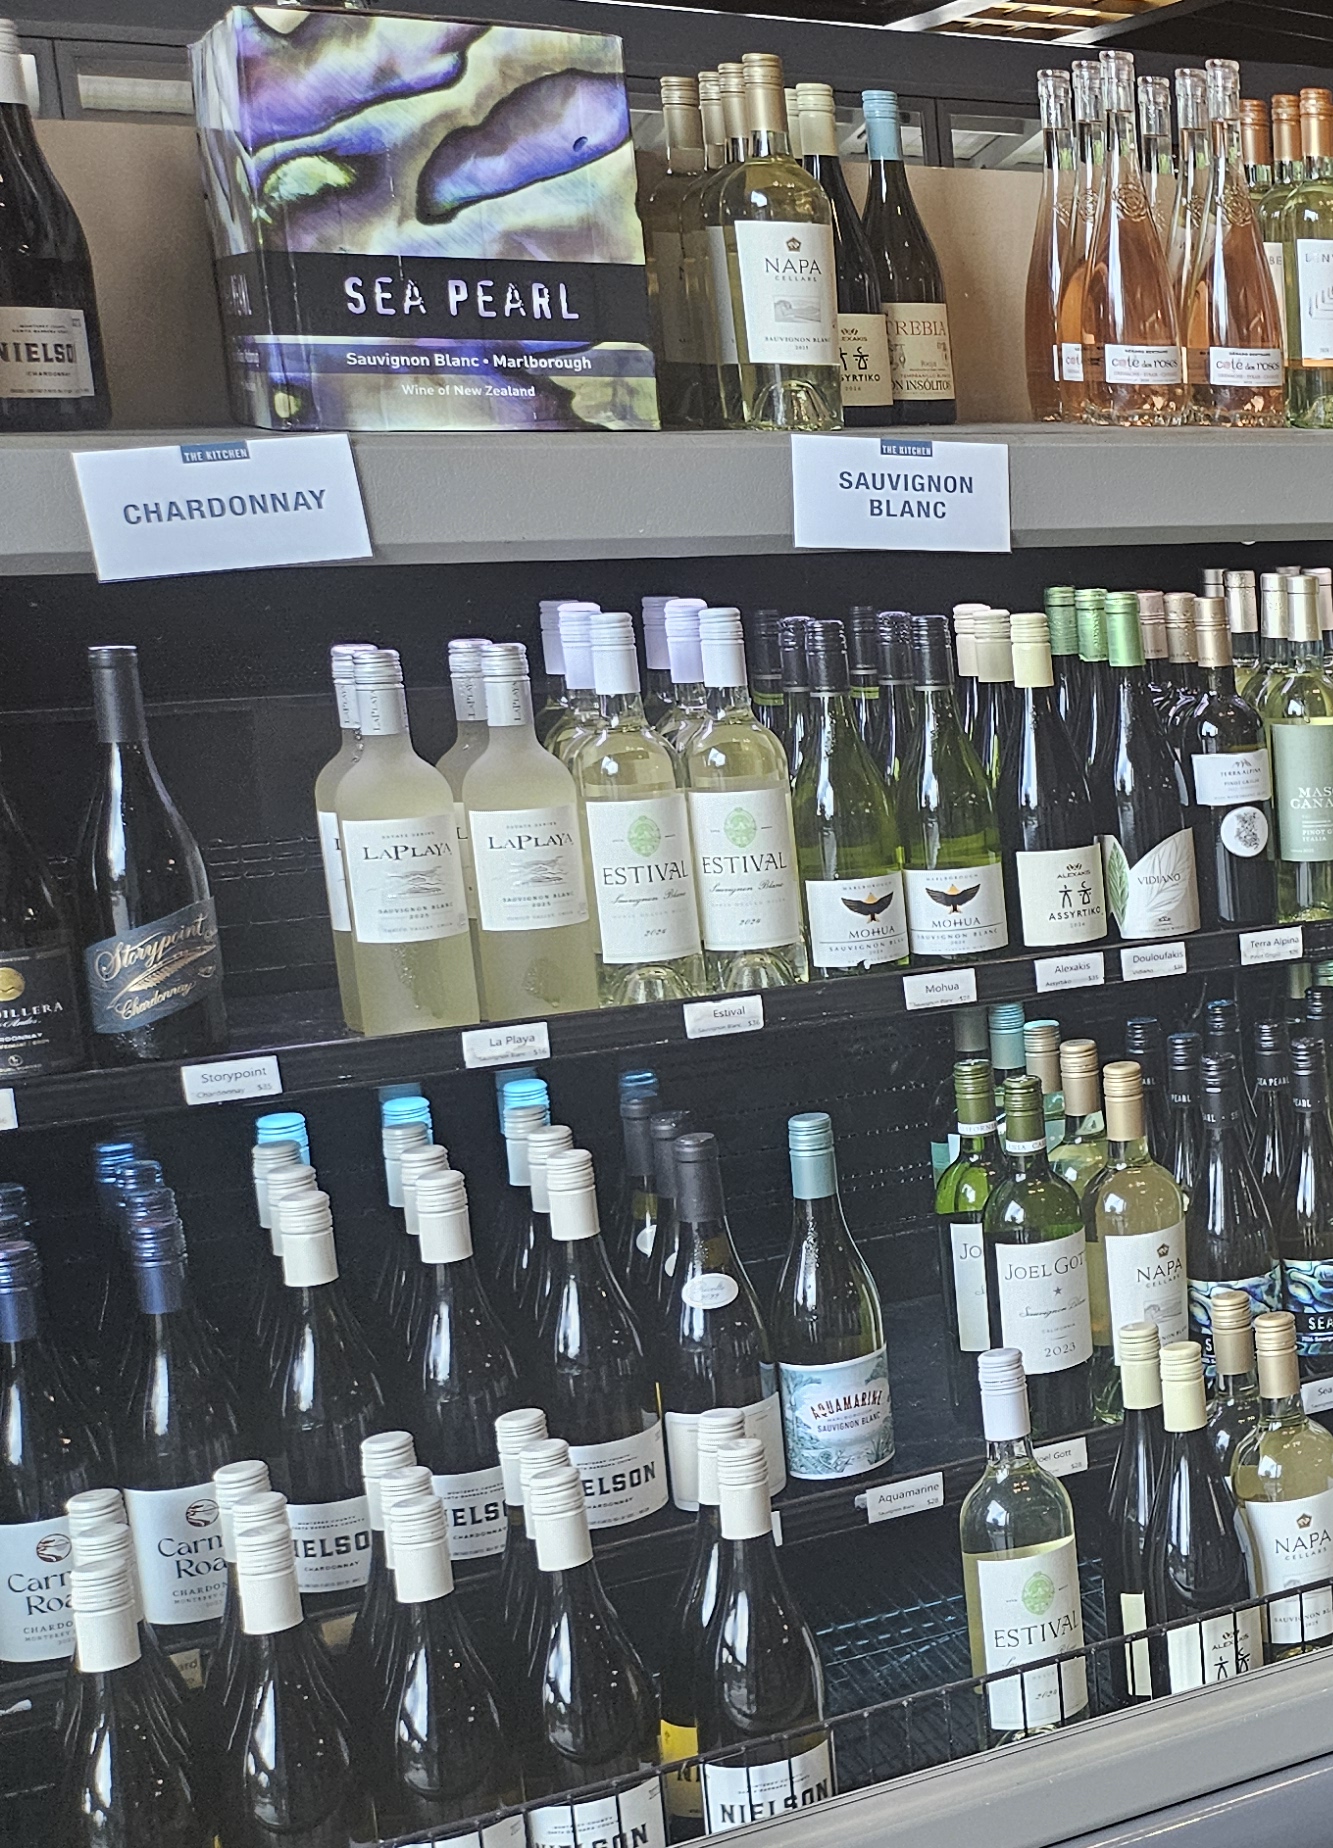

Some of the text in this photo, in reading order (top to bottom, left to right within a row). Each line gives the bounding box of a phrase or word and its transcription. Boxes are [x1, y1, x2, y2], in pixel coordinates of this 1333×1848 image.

[765, 258, 822, 275] NAPA
[344, 276, 580, 320] SEA PEARL
[346, 352, 592, 372] Sauvignon Blanc Marlborough
[401, 384, 535, 399] Wine of New Zealand
[184, 449, 247, 461] THE KITCHEN
[883, 445, 931, 455] THE KITCHEN
[839, 471, 973, 493] SAUVIGNON
[124, 490, 325, 525] CHARDONNAY
[870, 499, 946, 518] BLANC
[702, 852, 787, 875] ESTIVAL
[603, 860, 688, 886] ESTIVAL
[1137, 873, 1181, 885] VIDIANO
[1049, 907, 1101, 921] ASSYRTIKO
[932, 918, 981, 929] MOHUA
[848, 926, 895, 940] MOHUA
[96, 914, 208, 982] Storypoint
[1251, 936, 1299, 948] Terra Alpina
[1133, 951, 1183, 963] Douloufakis
[1054, 962, 1091, 974] Alexakis
[925, 983, 960, 994] Mohua
[115, 980, 195, 1020] Chardonnay
[714, 1006, 745, 1018] Estival
[490, 1034, 536, 1046] La Playa
[201, 1067, 267, 1084] Storypoint
[1004, 1262, 1052, 1282] JOEL
[1136, 1255, 1182, 1283] NAPA
[1308, 1313, 1333, 1331] SEA
[1044, 1342, 1076, 1359] 2023
[810, 1390, 883, 1420] AQUAMARINE
[817, 1412, 881, 1434] SAUVIGNON BLANC
[1053, 1448, 1071, 1459] Gott
[878, 1482, 939, 1504] Aquamarine
[1275, 1529, 1332, 1554] NAPA
[1284, 1546, 1327, 1561] CELLARS
[175, 1556, 227, 1578] Roa
[993, 1609, 1079, 1649] ESTIVAL
